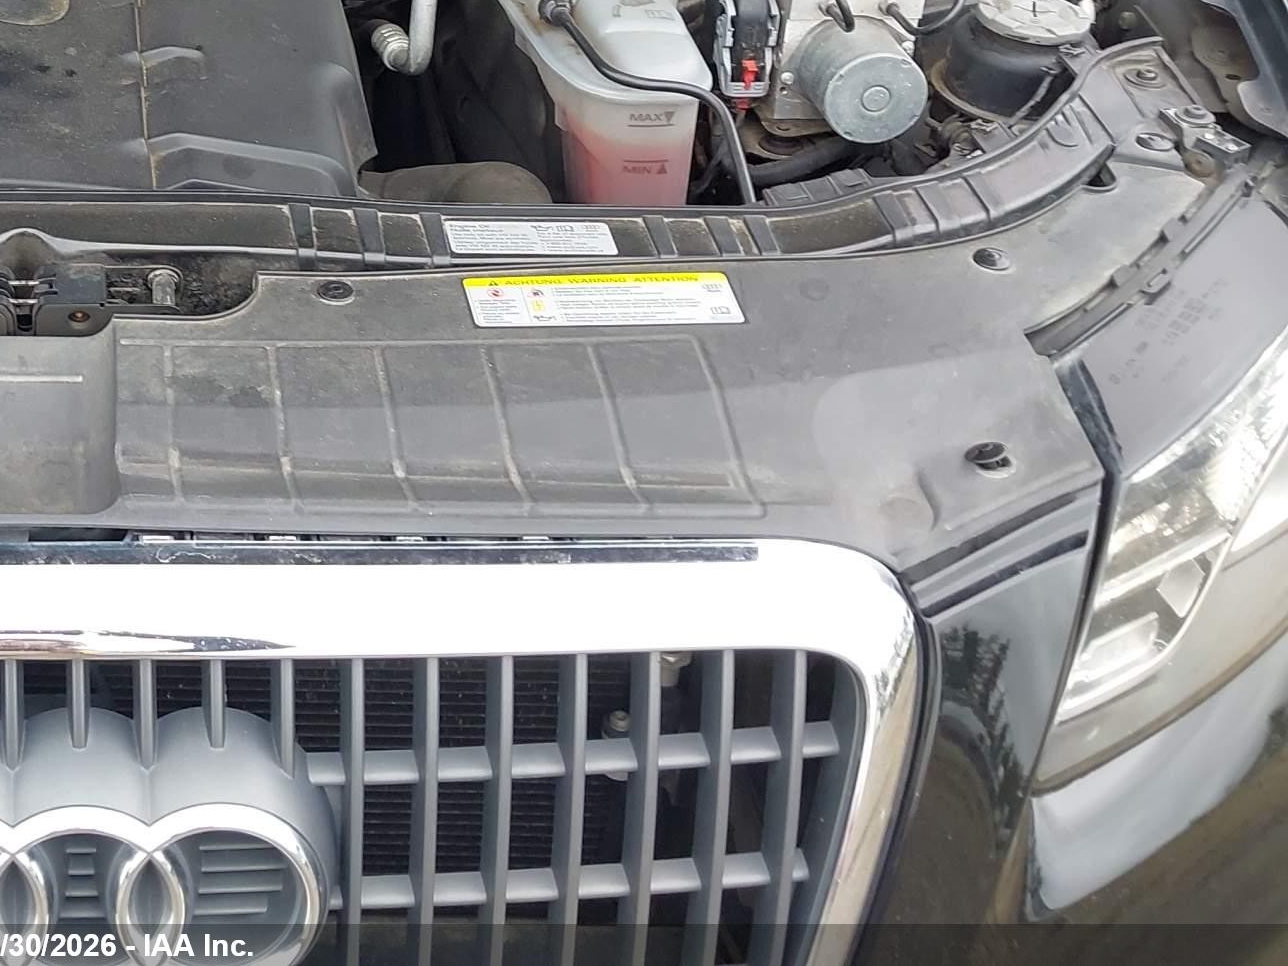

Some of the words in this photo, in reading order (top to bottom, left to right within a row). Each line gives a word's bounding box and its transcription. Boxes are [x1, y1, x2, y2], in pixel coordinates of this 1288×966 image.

[629, 113, 663, 121] MAX
[623, 166, 651, 174] MIN
[633, 275, 699, 283] ATTENTION
